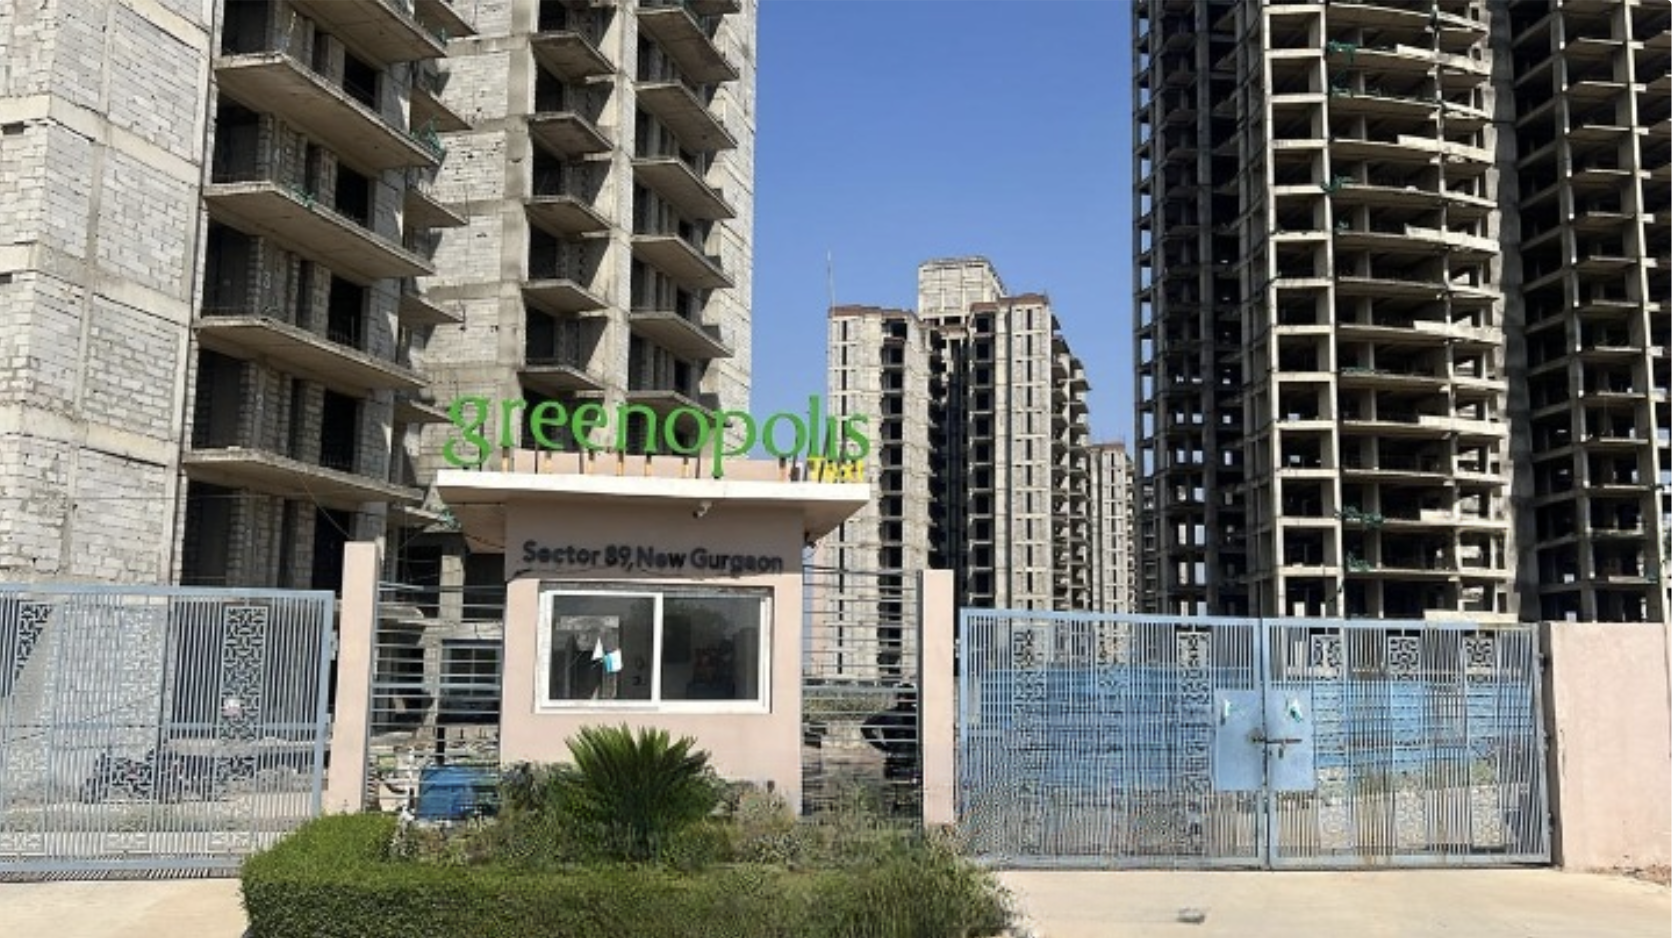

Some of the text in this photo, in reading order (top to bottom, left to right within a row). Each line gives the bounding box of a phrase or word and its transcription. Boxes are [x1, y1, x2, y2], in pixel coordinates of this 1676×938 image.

[443, 396, 870, 475] greenopolis
[522, 539, 601, 566] Sector
[636, 546, 687, 570] New
[690, 547, 784, 577] Gurgaon
